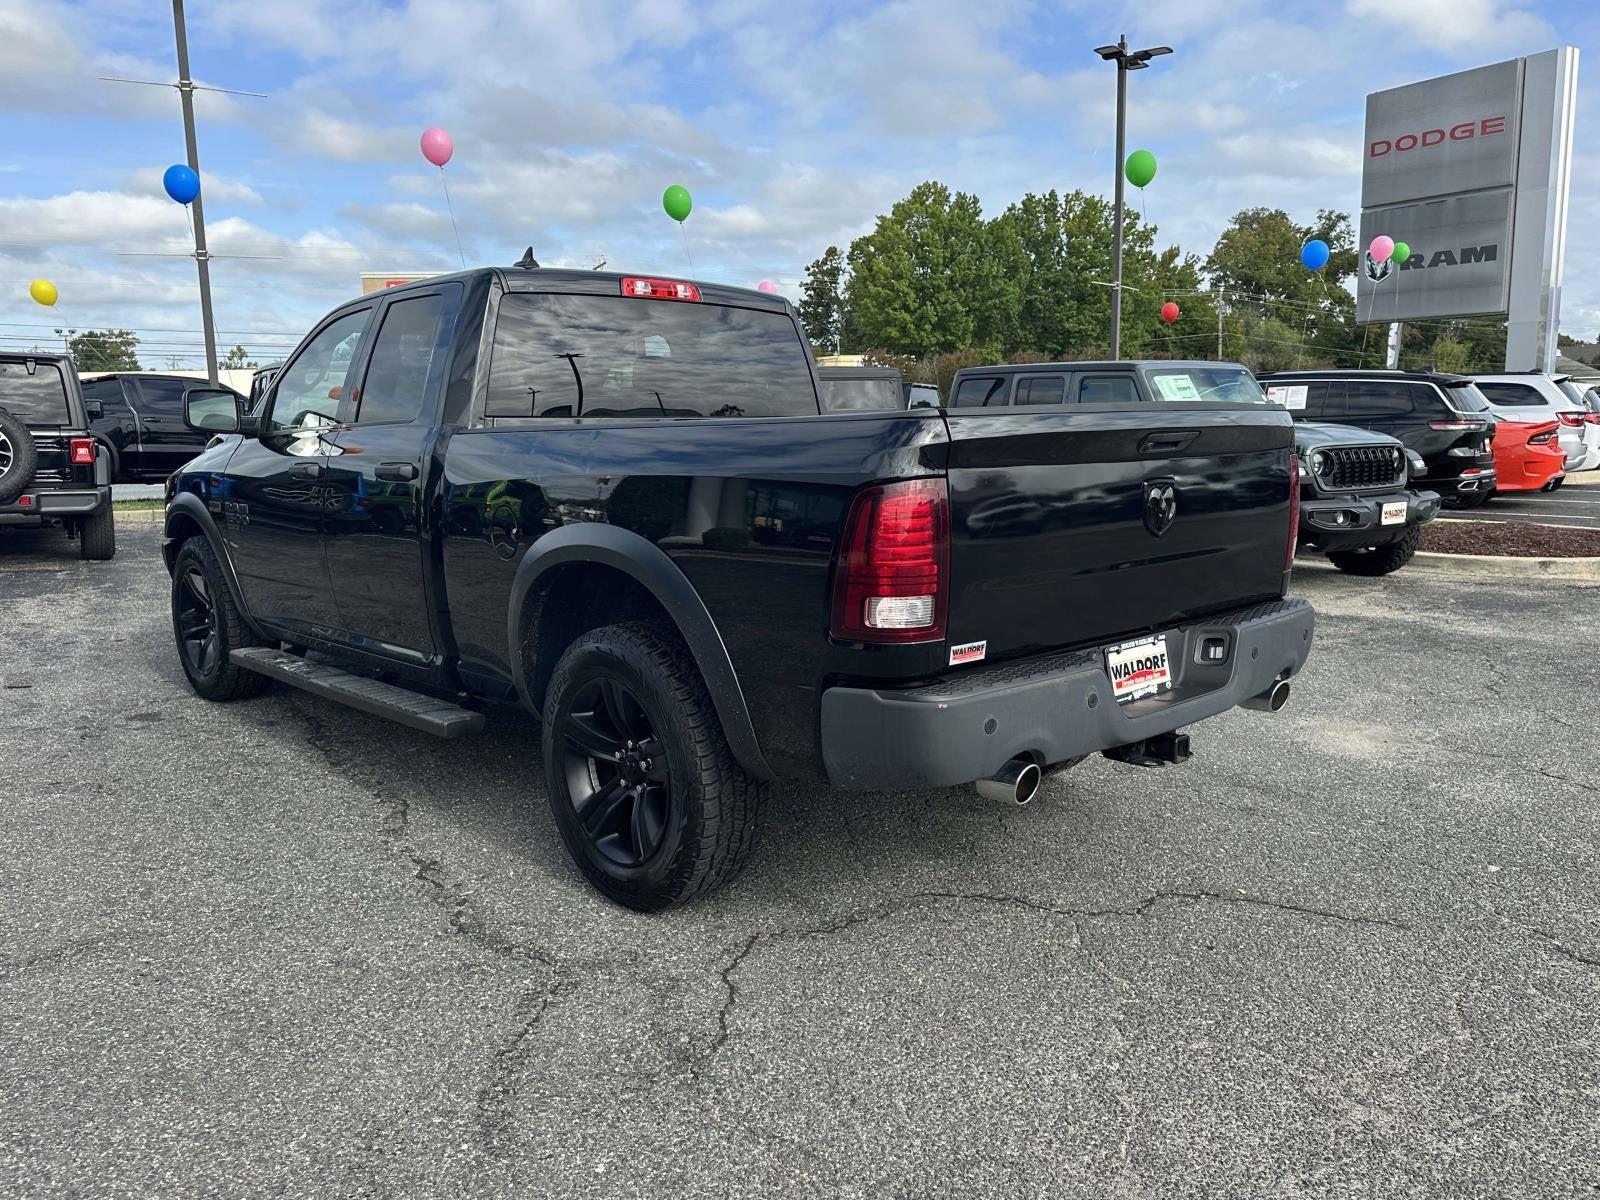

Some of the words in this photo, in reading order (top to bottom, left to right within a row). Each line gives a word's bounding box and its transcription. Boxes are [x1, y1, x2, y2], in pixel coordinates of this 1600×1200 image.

[1369, 115, 1506, 158] DODGE
[1400, 244, 1498, 271] RAM
[952, 644, 985, 656] WALDORF
[1111, 653, 1166, 680] WALDORF
